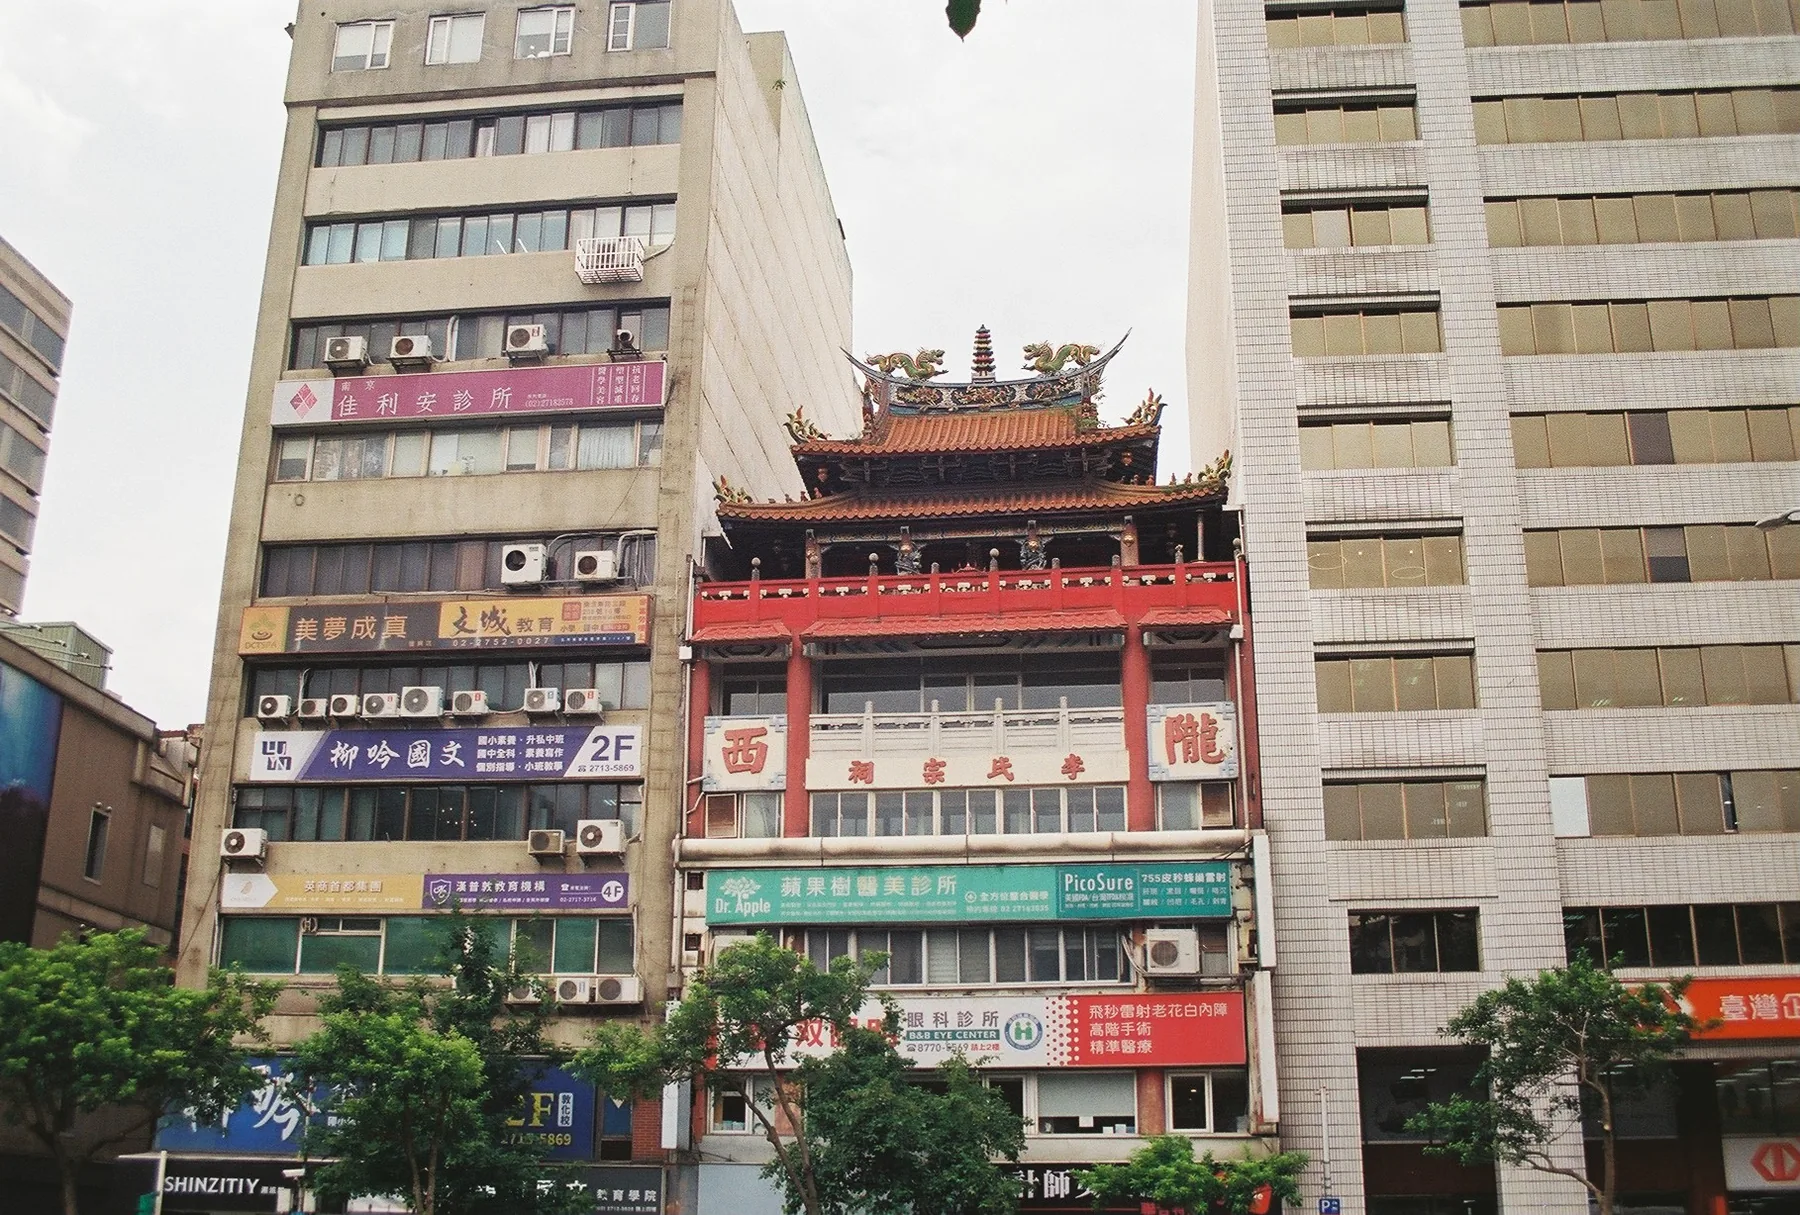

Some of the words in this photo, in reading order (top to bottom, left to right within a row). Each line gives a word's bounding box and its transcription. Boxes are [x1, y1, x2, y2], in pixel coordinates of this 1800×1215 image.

[337, 387, 513, 418] 佳利安診所
[294, 616, 408, 642] 美夢成真
[516, 616, 555, 633] 教育
[330, 739, 466, 770] 柳吟國文
[590, 735, 635, 762] 2F
[721, 727, 769, 775] 西
[589, 764, 635, 773] 2713-5869
[780, 875, 957, 897] 蘋果樹醫美診所
[1065, 873, 1133, 892] PicoSure
[603, 886, 622, 898] 4F
[715, 900, 731, 914] Dr.
[735, 897, 771, 917] Apple
[1089, 1003, 1228, 1019] 飛秒雷射老花白內障
[1719, 993, 1800, 1021] 臺灣企
[907, 1011, 999, 1028] 眼科診所
[909, 1032, 930, 1040] B&B
[934, 1031, 952, 1039] EYE
[956, 1031, 997, 1039] CENTER
[1089, 1022, 1152, 1037] 高階手術
[1090, 1040, 1152, 1055] 精準醫療
[1321, 1200, 1331, 1213] P
